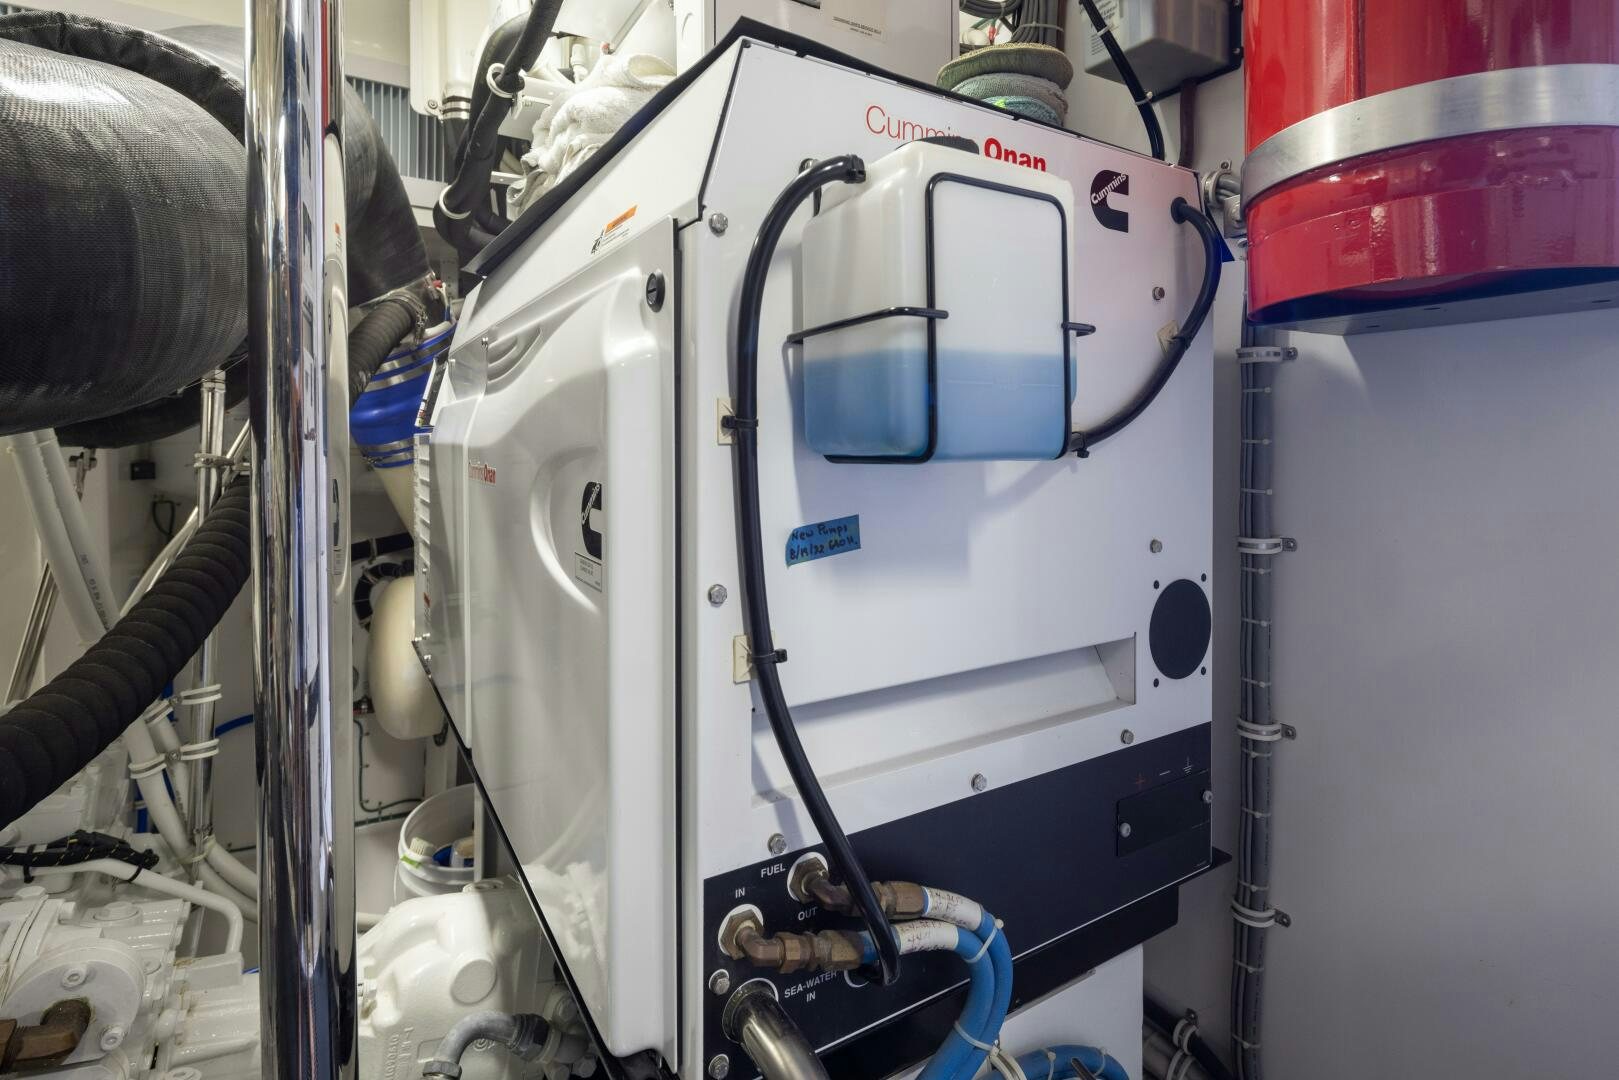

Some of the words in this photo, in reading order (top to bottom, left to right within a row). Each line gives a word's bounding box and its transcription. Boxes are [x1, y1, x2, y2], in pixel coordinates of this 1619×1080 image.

[983, 137, 1047, 172] Onan
[1091, 172, 1127, 205] Cummins
[791, 529, 814, 541] New
[760, 863, 786, 878] FUEL
[735, 887, 746, 899] IN
[797, 906, 818, 921] OUT
[806, 991, 816, 1003] IN
